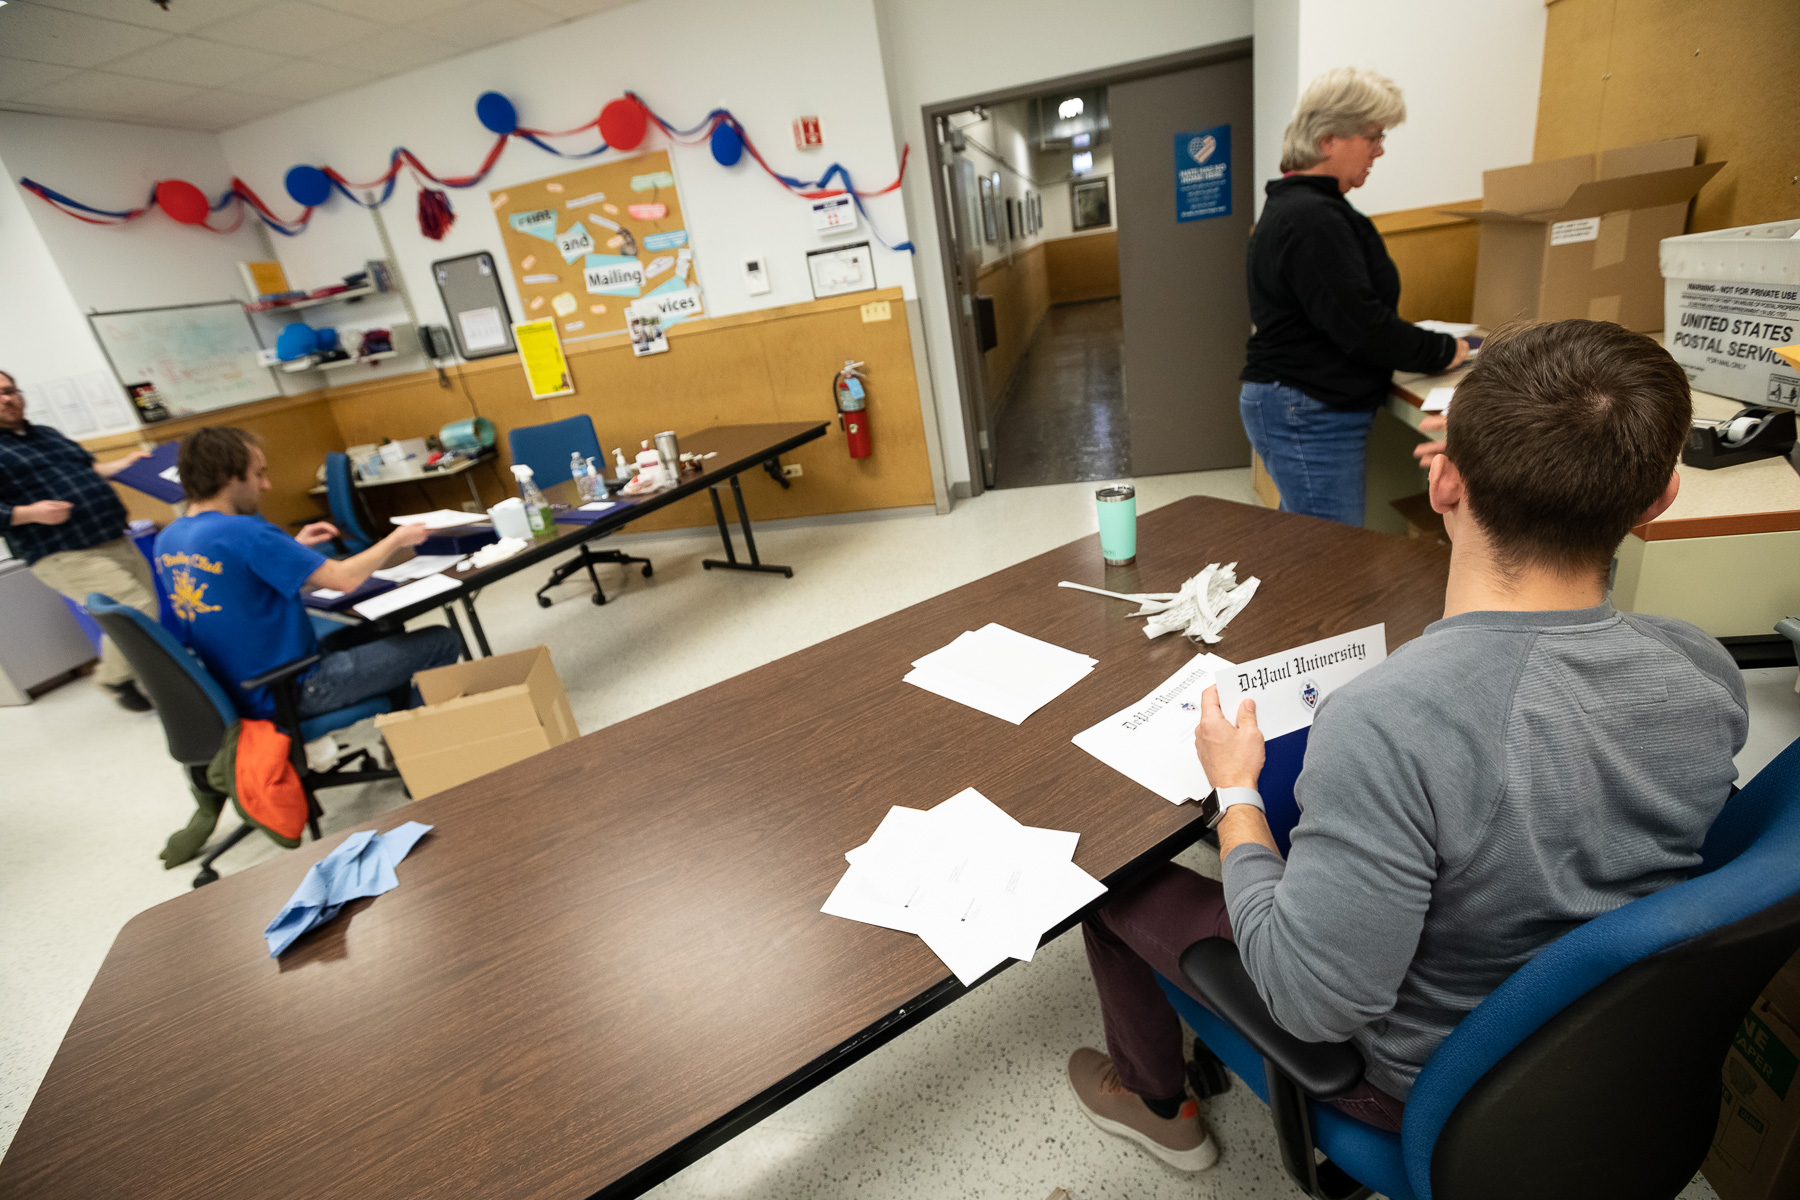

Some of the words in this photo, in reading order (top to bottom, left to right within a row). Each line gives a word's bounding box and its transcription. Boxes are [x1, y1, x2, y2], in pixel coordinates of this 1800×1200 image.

[562, 235, 590, 251] and
[589, 268, 642, 288] Mailing
[1688, 284, 1715, 292] WARNING
[1720, 286, 1734, 294] NOT
[1734, 287, 1749, 296] FOR
[1750, 288, 1780, 299] PRIVATE
[1781, 291, 1798, 300] USE
[658, 296, 695, 313] vices
[1680, 312, 1728, 333] UNITED
[1731, 319, 1793, 343] STATES
[1673, 332, 1723, 354] POSTAL
[1727, 341, 1792, 367] SERVIC
[1238, 666, 1291, 693] DePaul
[1294, 643, 1366, 676] University
[1122, 703, 1163, 730] DePaul
[1155, 668, 1208, 704] University
[1736, 1032, 1774, 1079] APER
